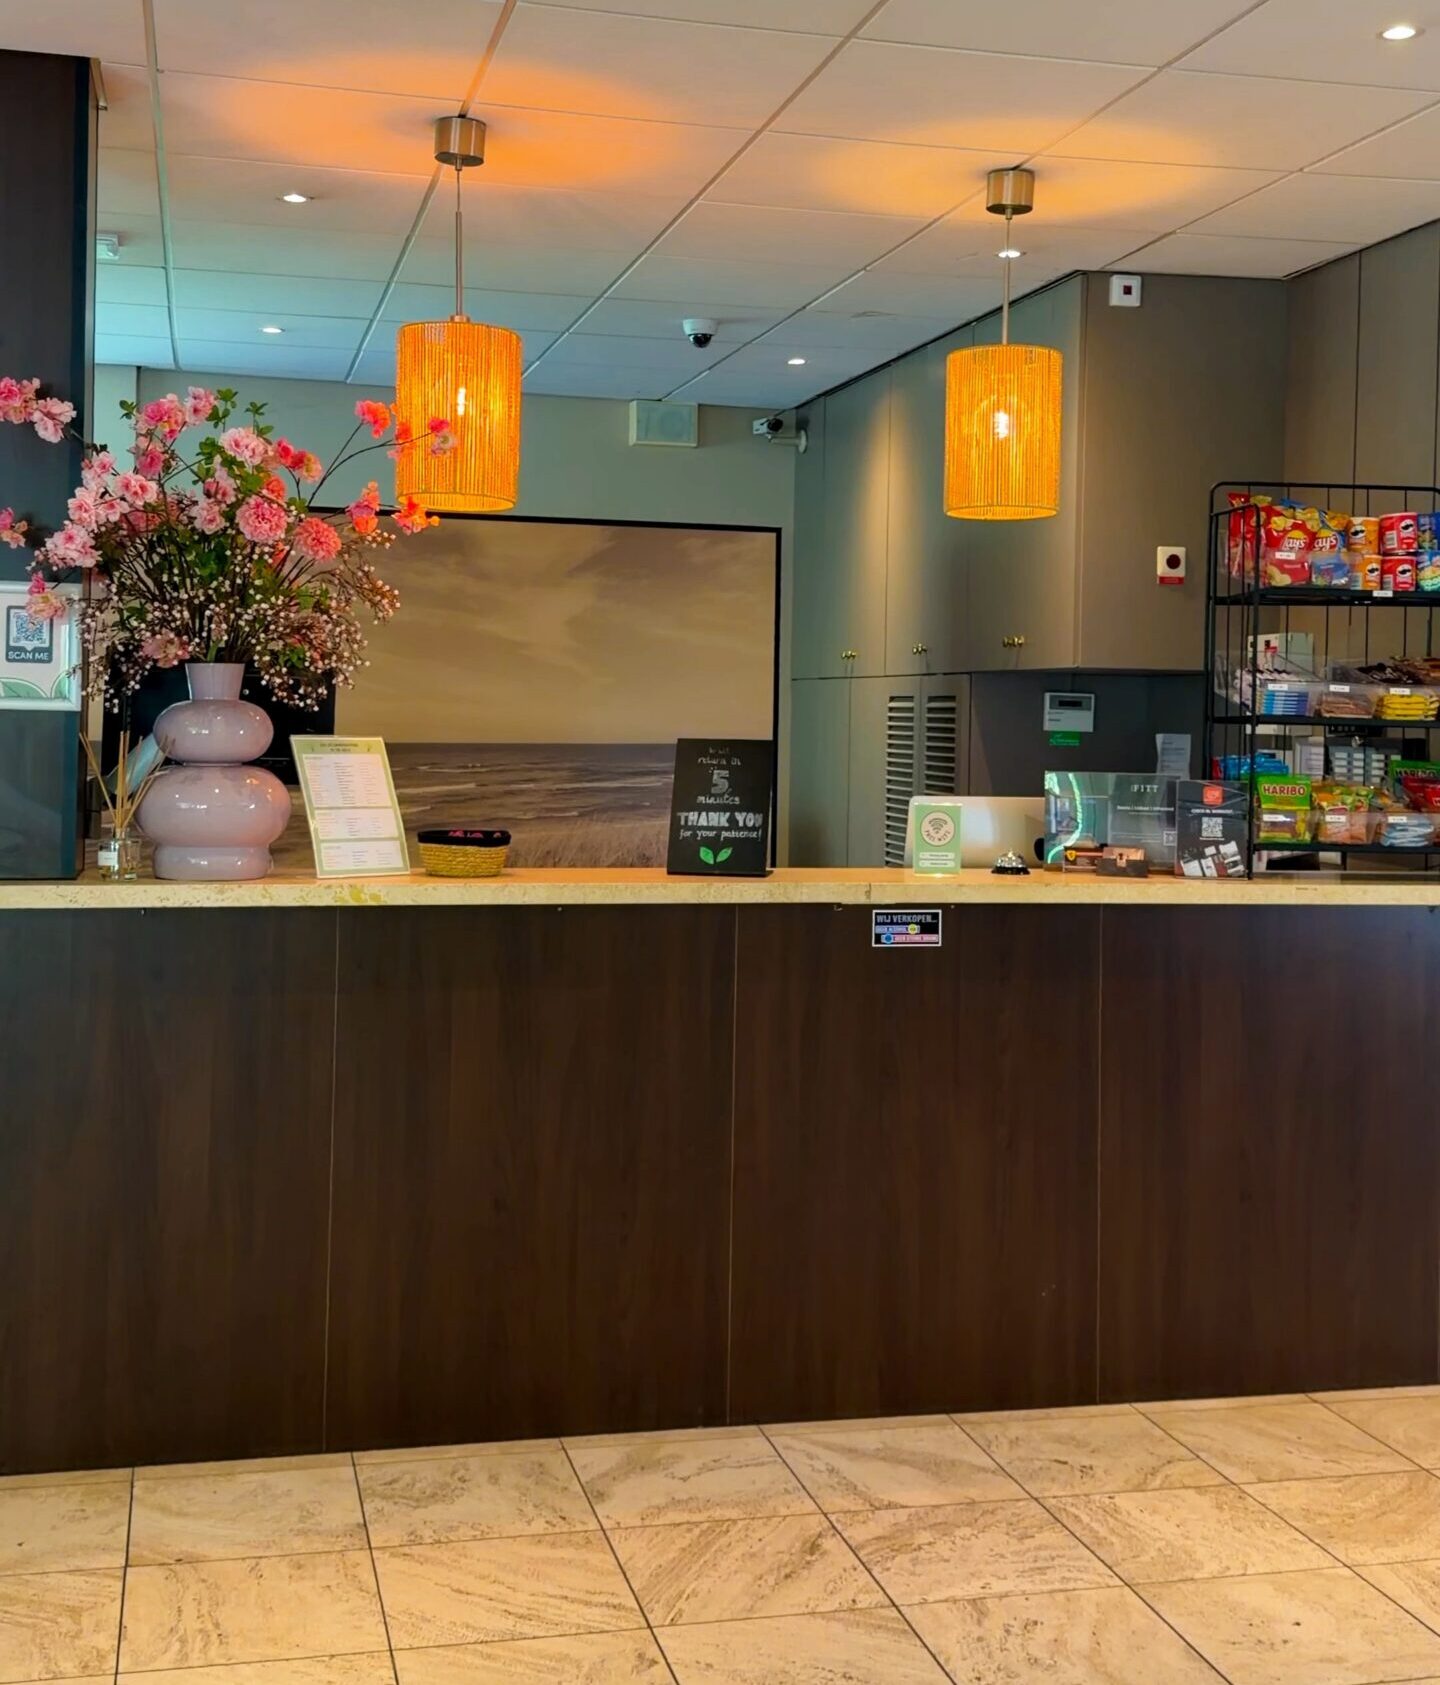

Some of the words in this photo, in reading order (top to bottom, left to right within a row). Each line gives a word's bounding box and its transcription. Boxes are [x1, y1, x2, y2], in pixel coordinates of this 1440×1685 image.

[8, 651, 33, 660] SCAN
[35, 652, 49, 661] ME
[711, 769, 730, 794] 5
[1263, 784, 1307, 796] HARIBO
[696, 790, 740, 805] minutes
[677, 811, 730, 828] THANK
[735, 812, 764, 828] YOU
[679, 829, 693, 840] for
[696, 830, 717, 841] your
[720, 830, 762, 842] patience!
[876, 914, 891, 923] WIJ
